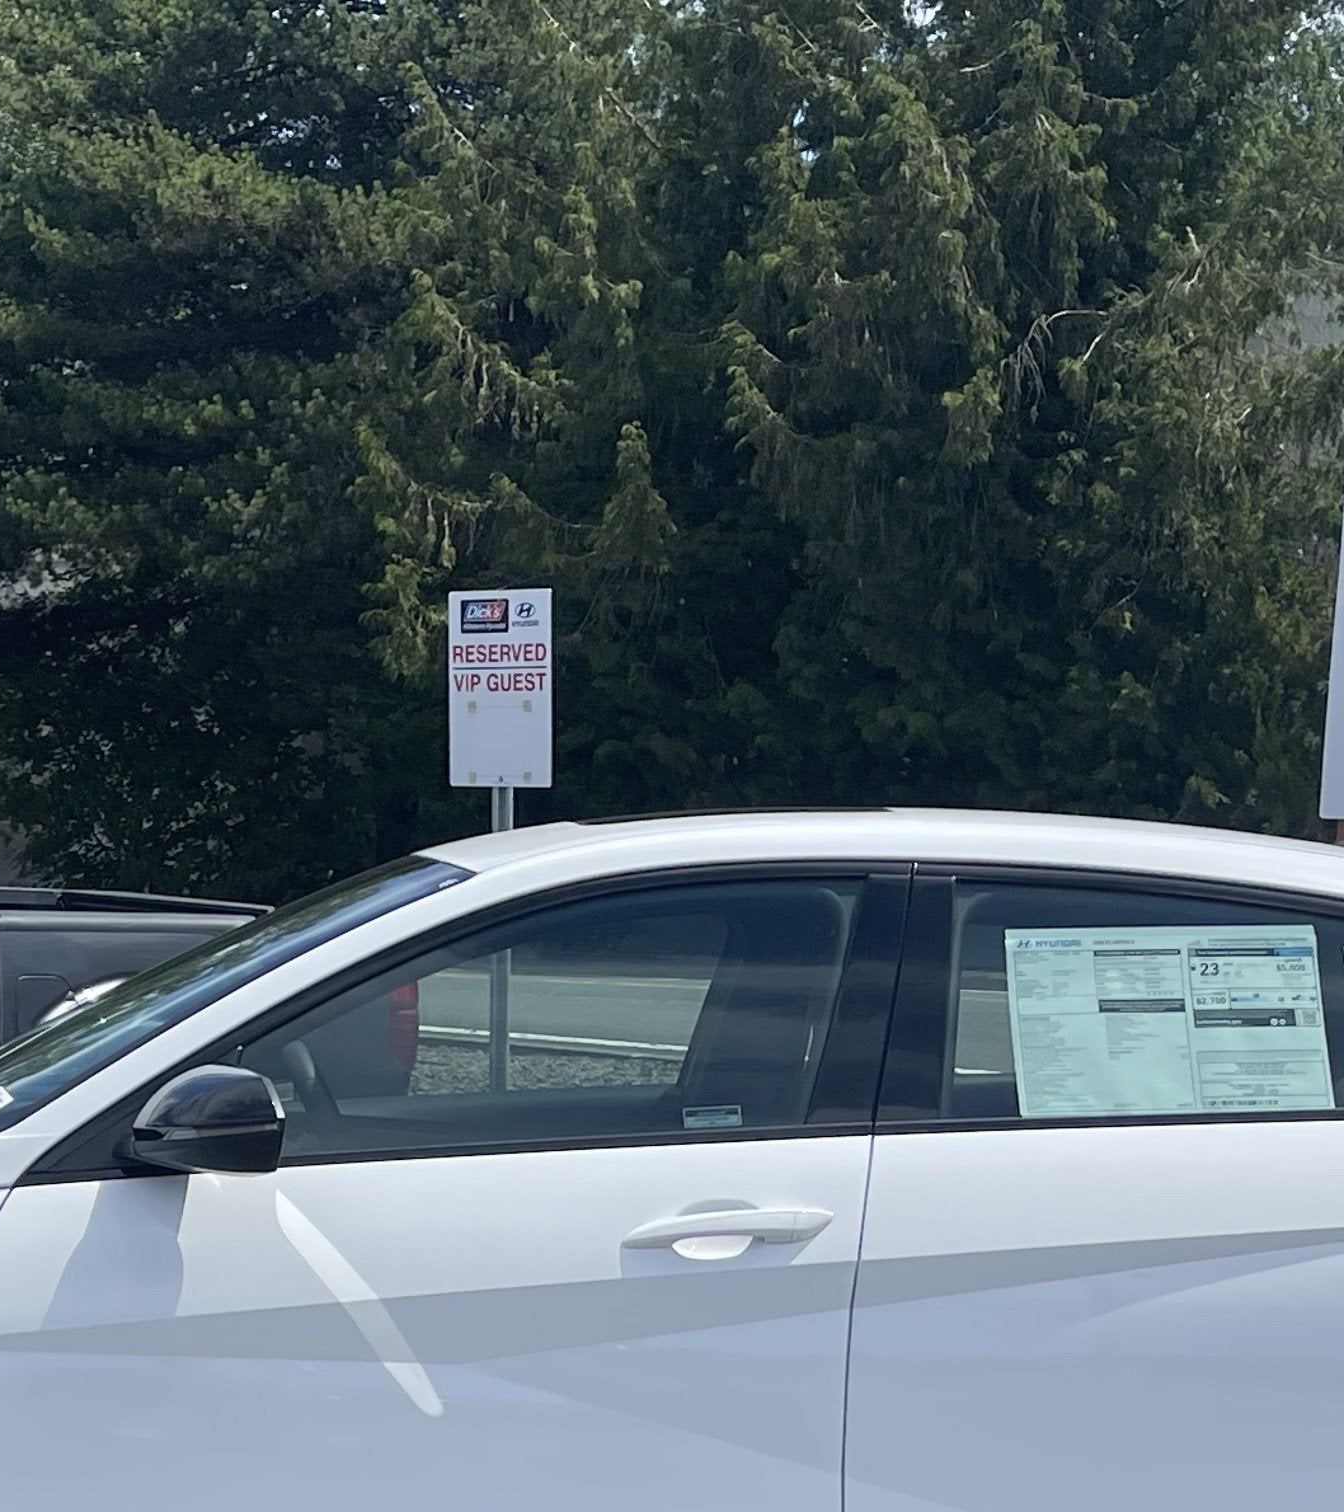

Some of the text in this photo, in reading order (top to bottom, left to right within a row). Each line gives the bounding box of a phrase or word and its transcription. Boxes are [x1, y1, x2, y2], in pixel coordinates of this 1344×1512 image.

[452, 643, 547, 663] RESERVED
[453, 672, 547, 692] VIP GUEST
[1199, 962, 1220, 977] 23
